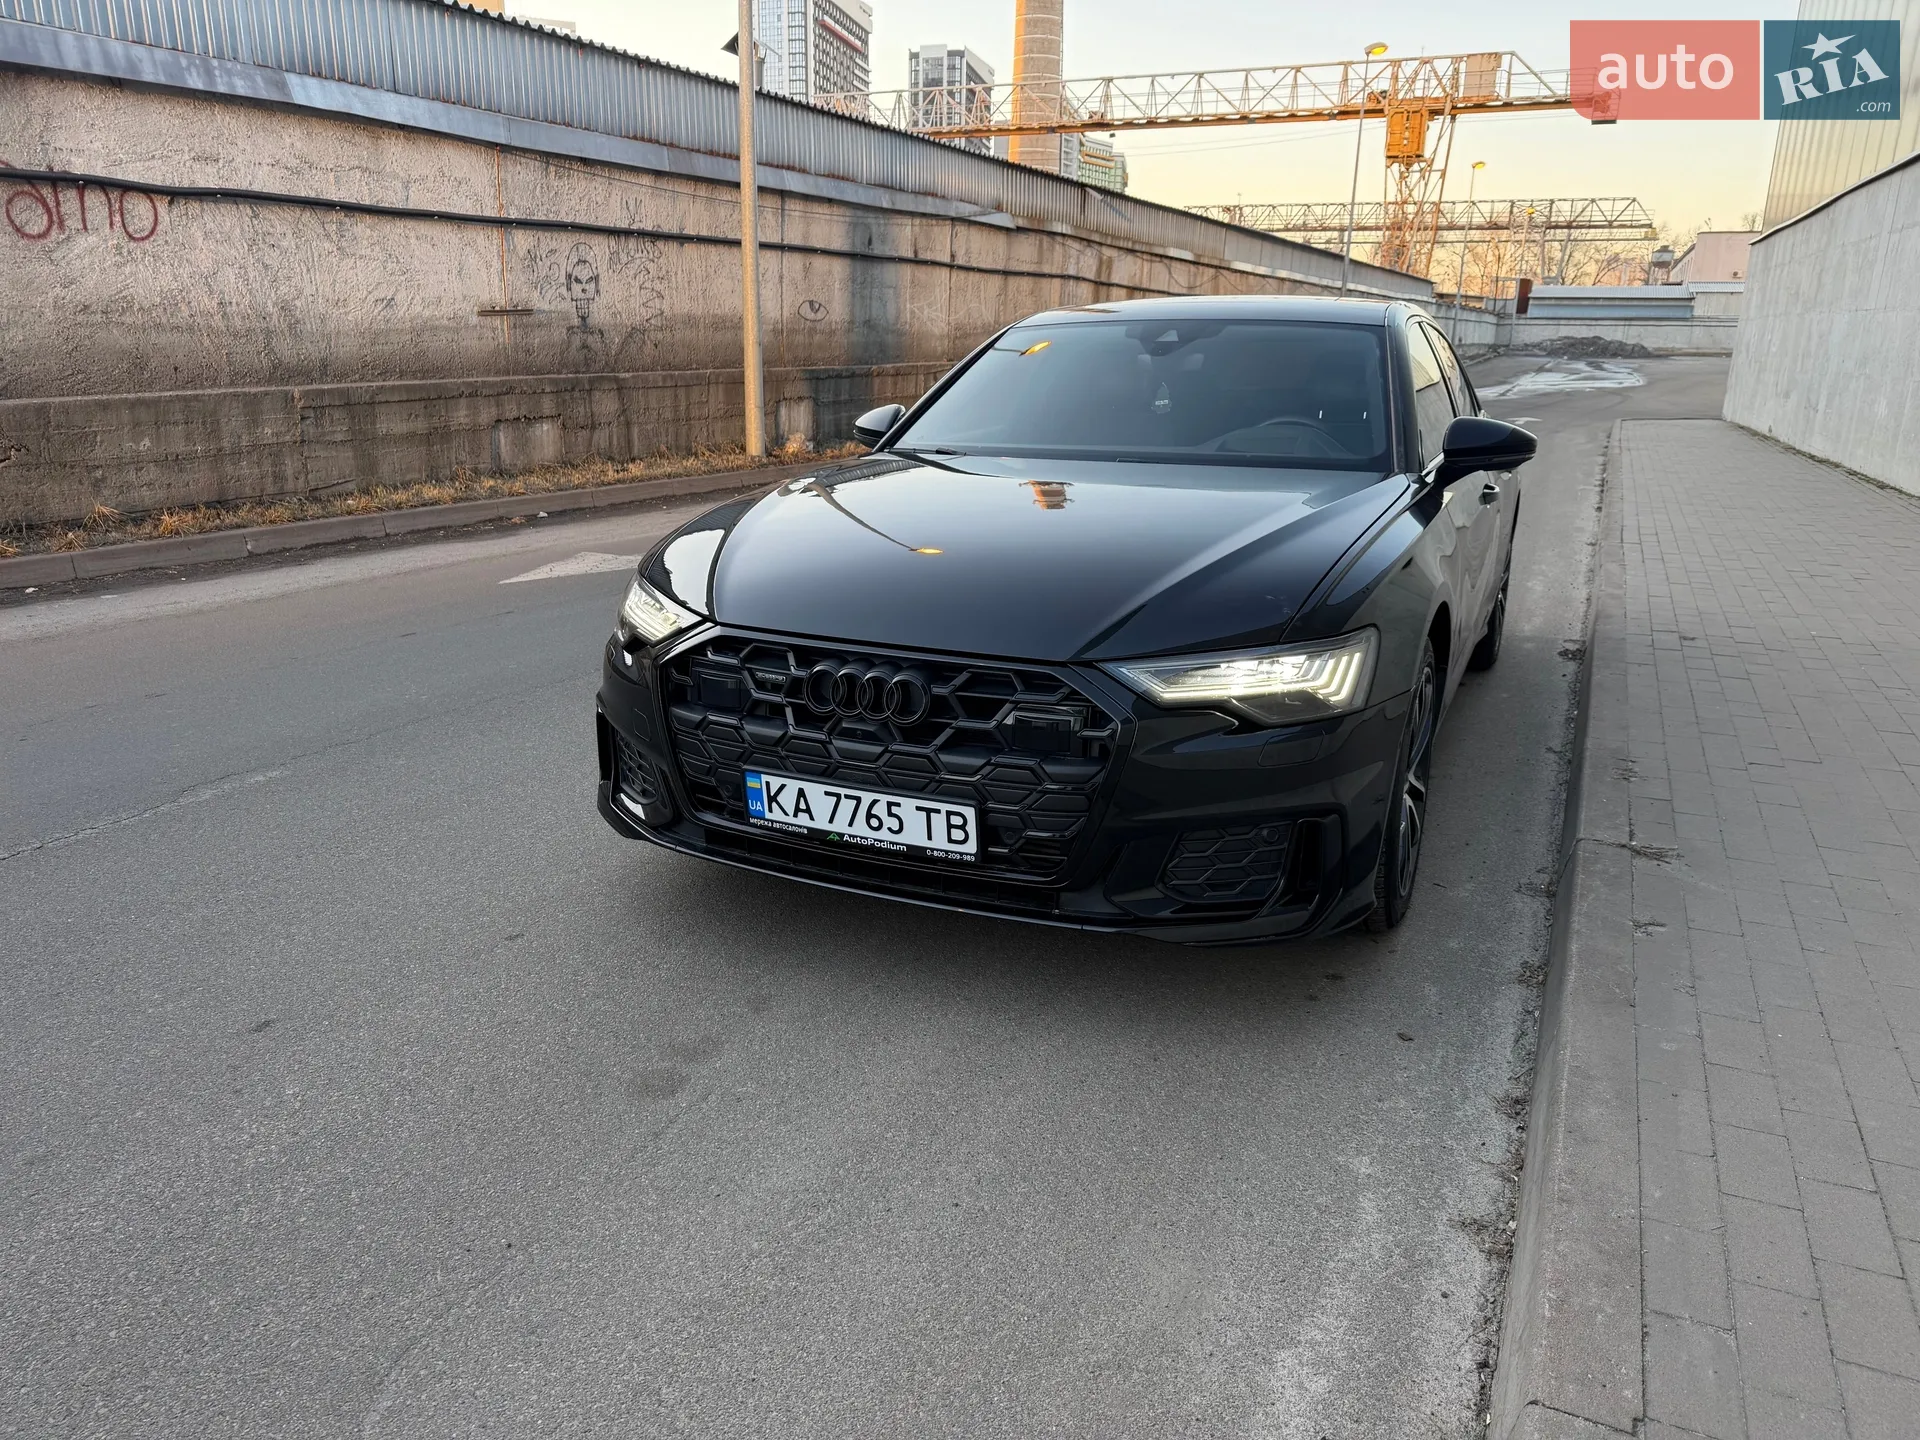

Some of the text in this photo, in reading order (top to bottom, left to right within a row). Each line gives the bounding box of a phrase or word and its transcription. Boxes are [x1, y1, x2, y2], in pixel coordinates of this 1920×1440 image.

[748, 799, 763, 812] UA
[824, 790, 904, 835] 7765
[749, 817, 772, 828] мережа
[843, 834, 907, 852] AutoPodium
[926, 849, 975, 862] 0-800-209-989
